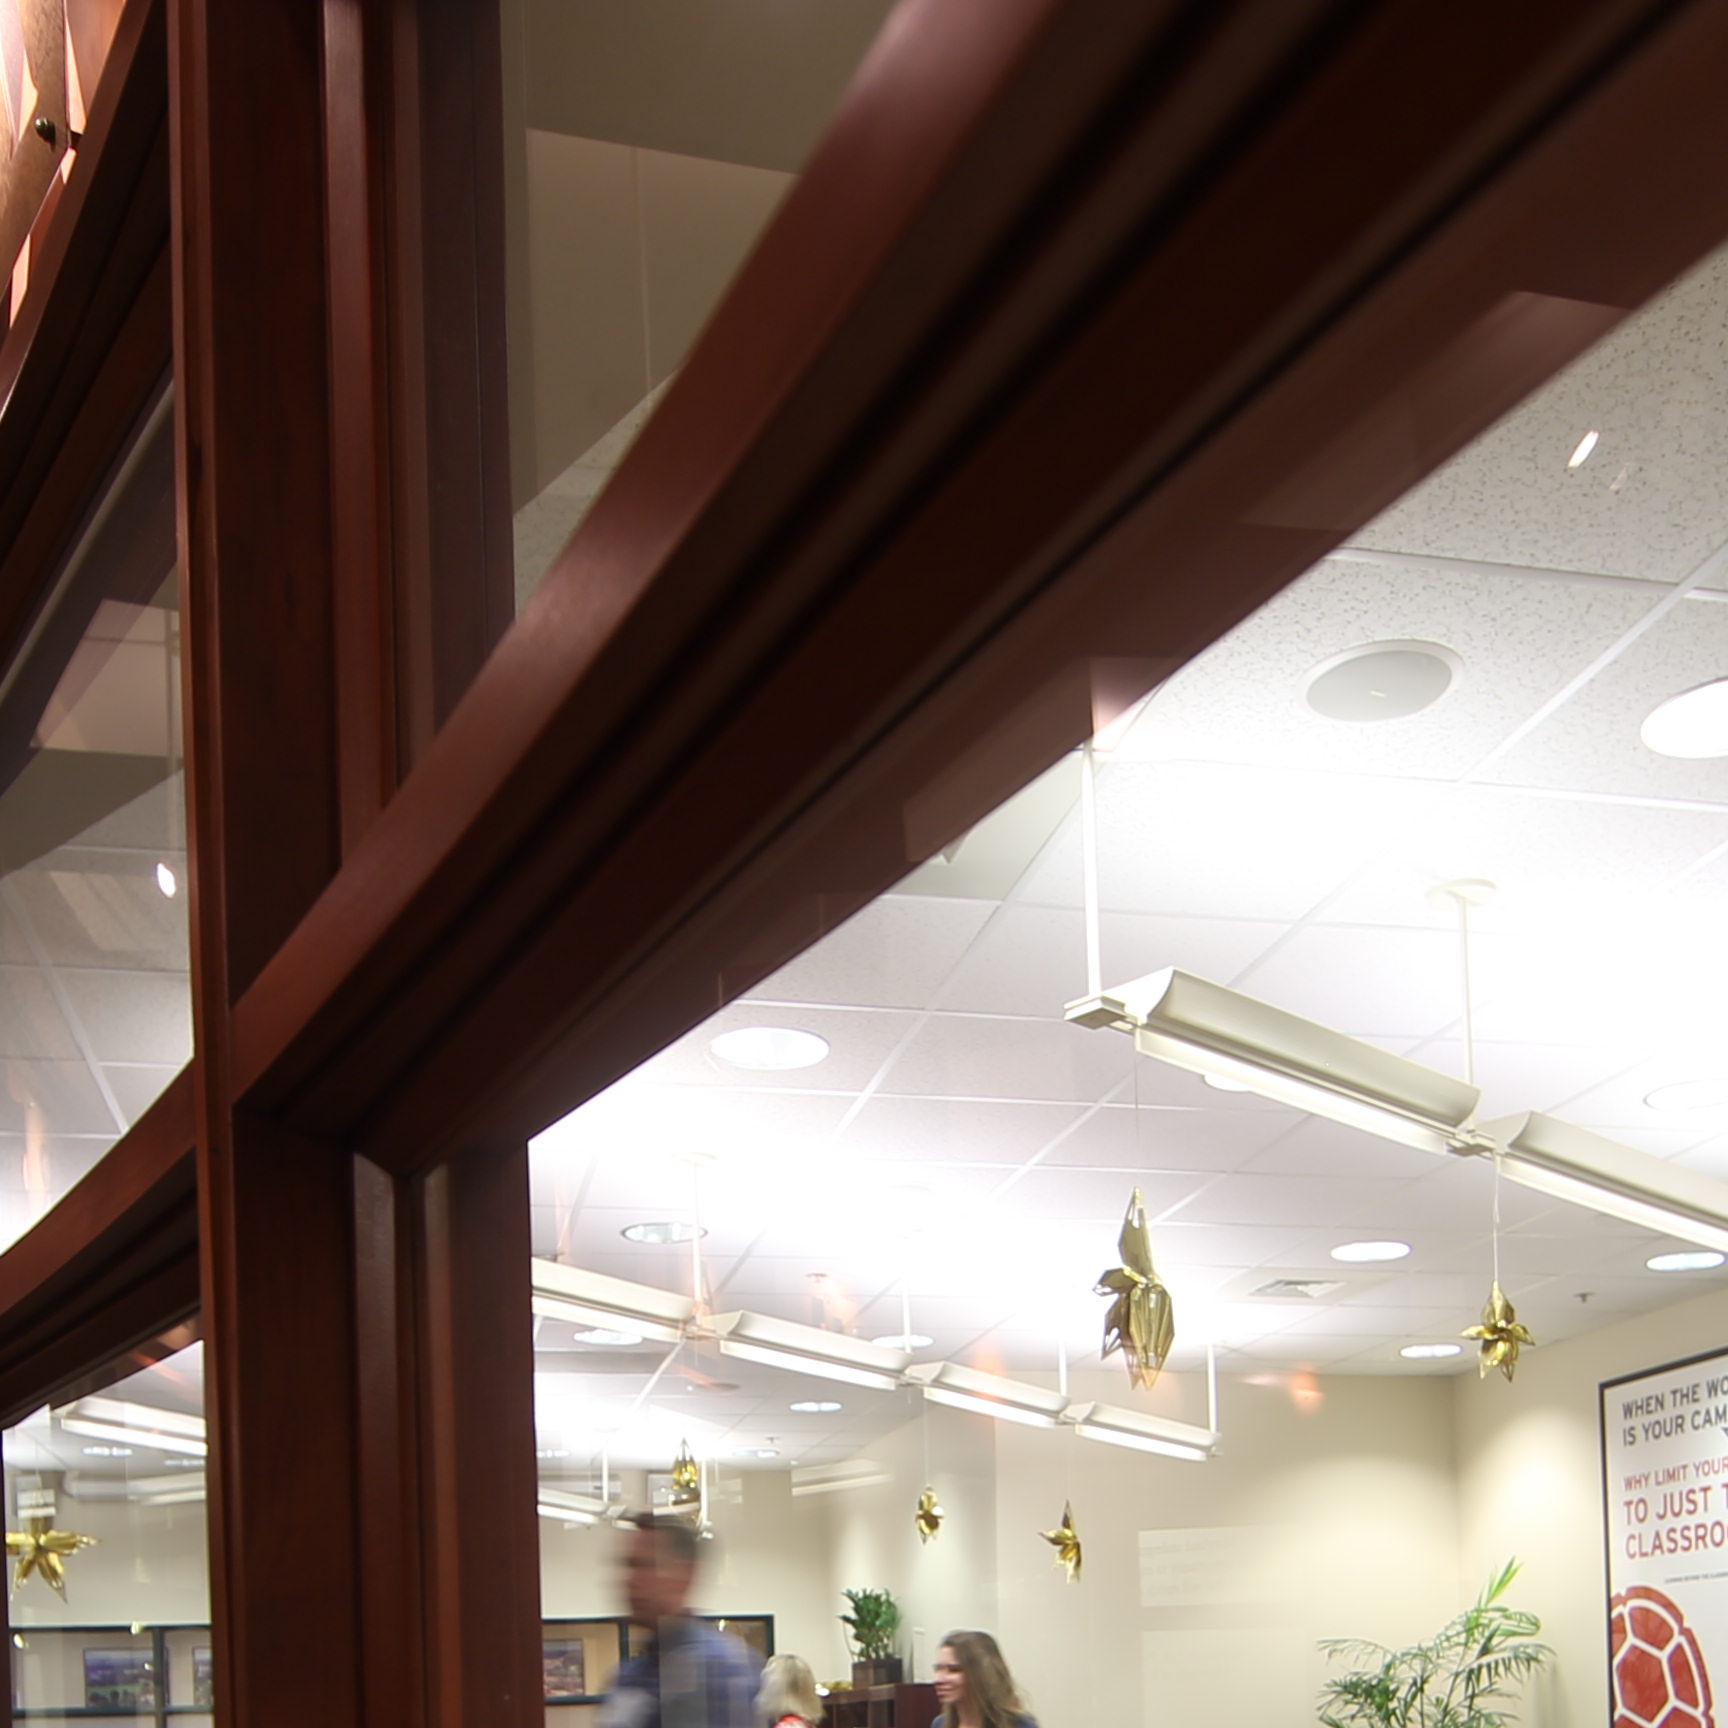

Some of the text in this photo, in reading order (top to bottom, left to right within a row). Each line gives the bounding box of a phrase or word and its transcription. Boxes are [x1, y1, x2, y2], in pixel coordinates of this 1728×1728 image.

[1622, 1393, 1665, 1420] WHEN
[1670, 1384, 1700, 1407] THE
[1623, 1425, 1637, 1447] IS
[1641, 1413, 1685, 1440] YOUR
[1623, 1473, 1650, 1492] WHY
[1654, 1464, 1688, 1486] LIMIT
[1623, 1496, 1649, 1525] TO
[1656, 1485, 1712, 1521] JUST
